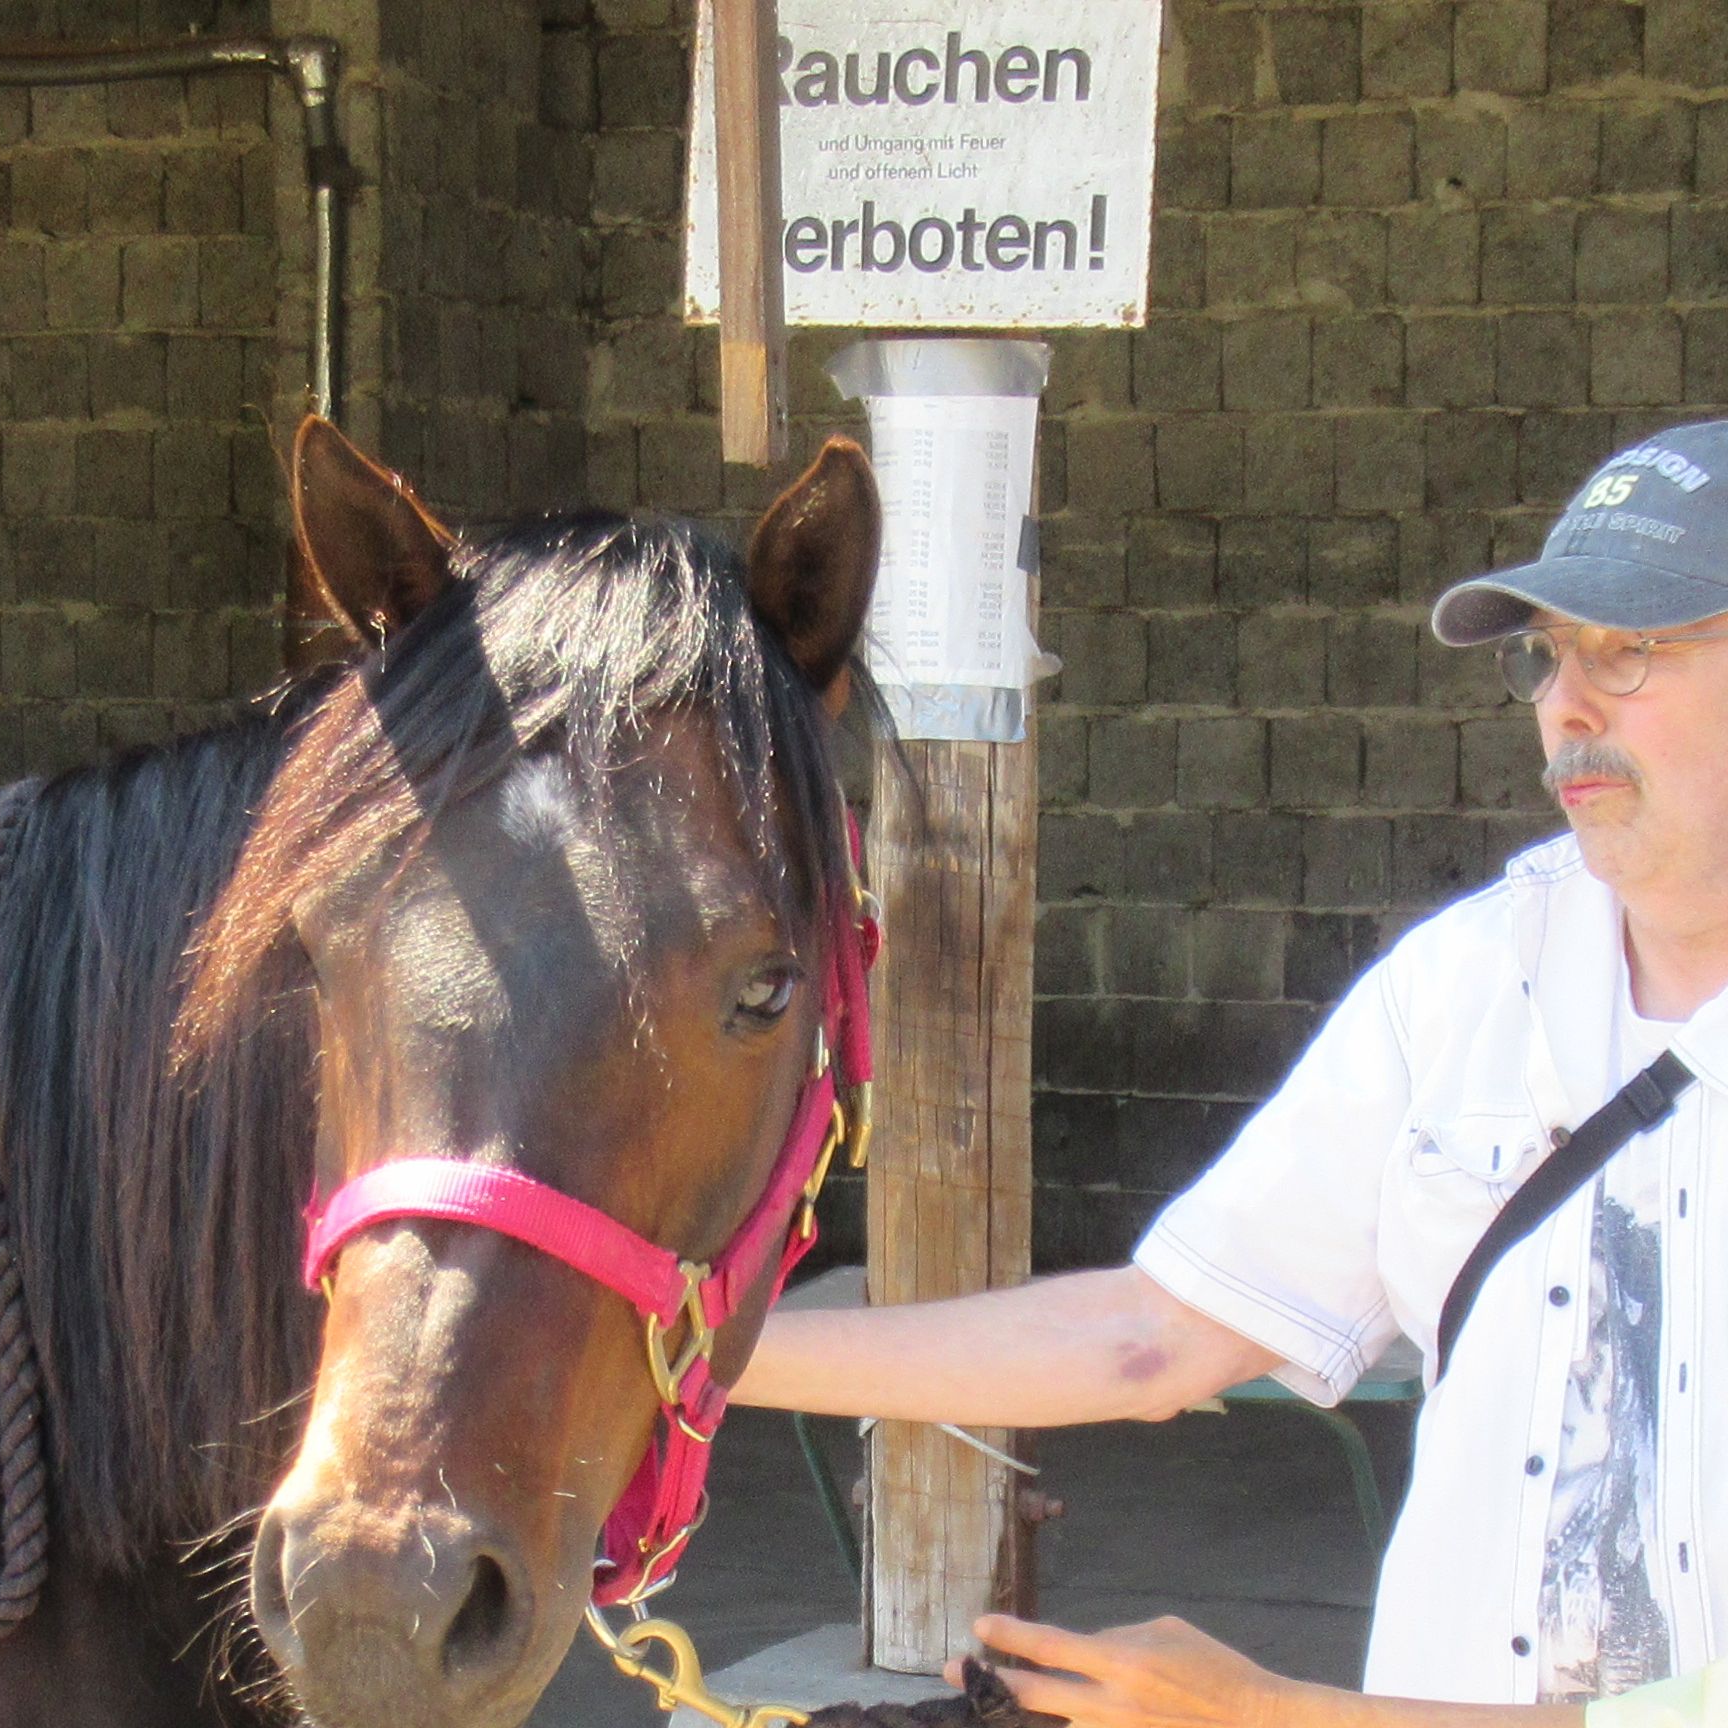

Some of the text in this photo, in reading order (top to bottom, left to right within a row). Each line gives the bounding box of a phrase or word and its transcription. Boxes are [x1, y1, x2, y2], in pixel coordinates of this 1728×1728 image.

[818, 133, 1006, 155] und Umgang mit Feuer
[828, 162, 978, 181] und offenem Licht
[780, 194, 1109, 273] erboten!
[1583, 474, 1639, 509] 85
